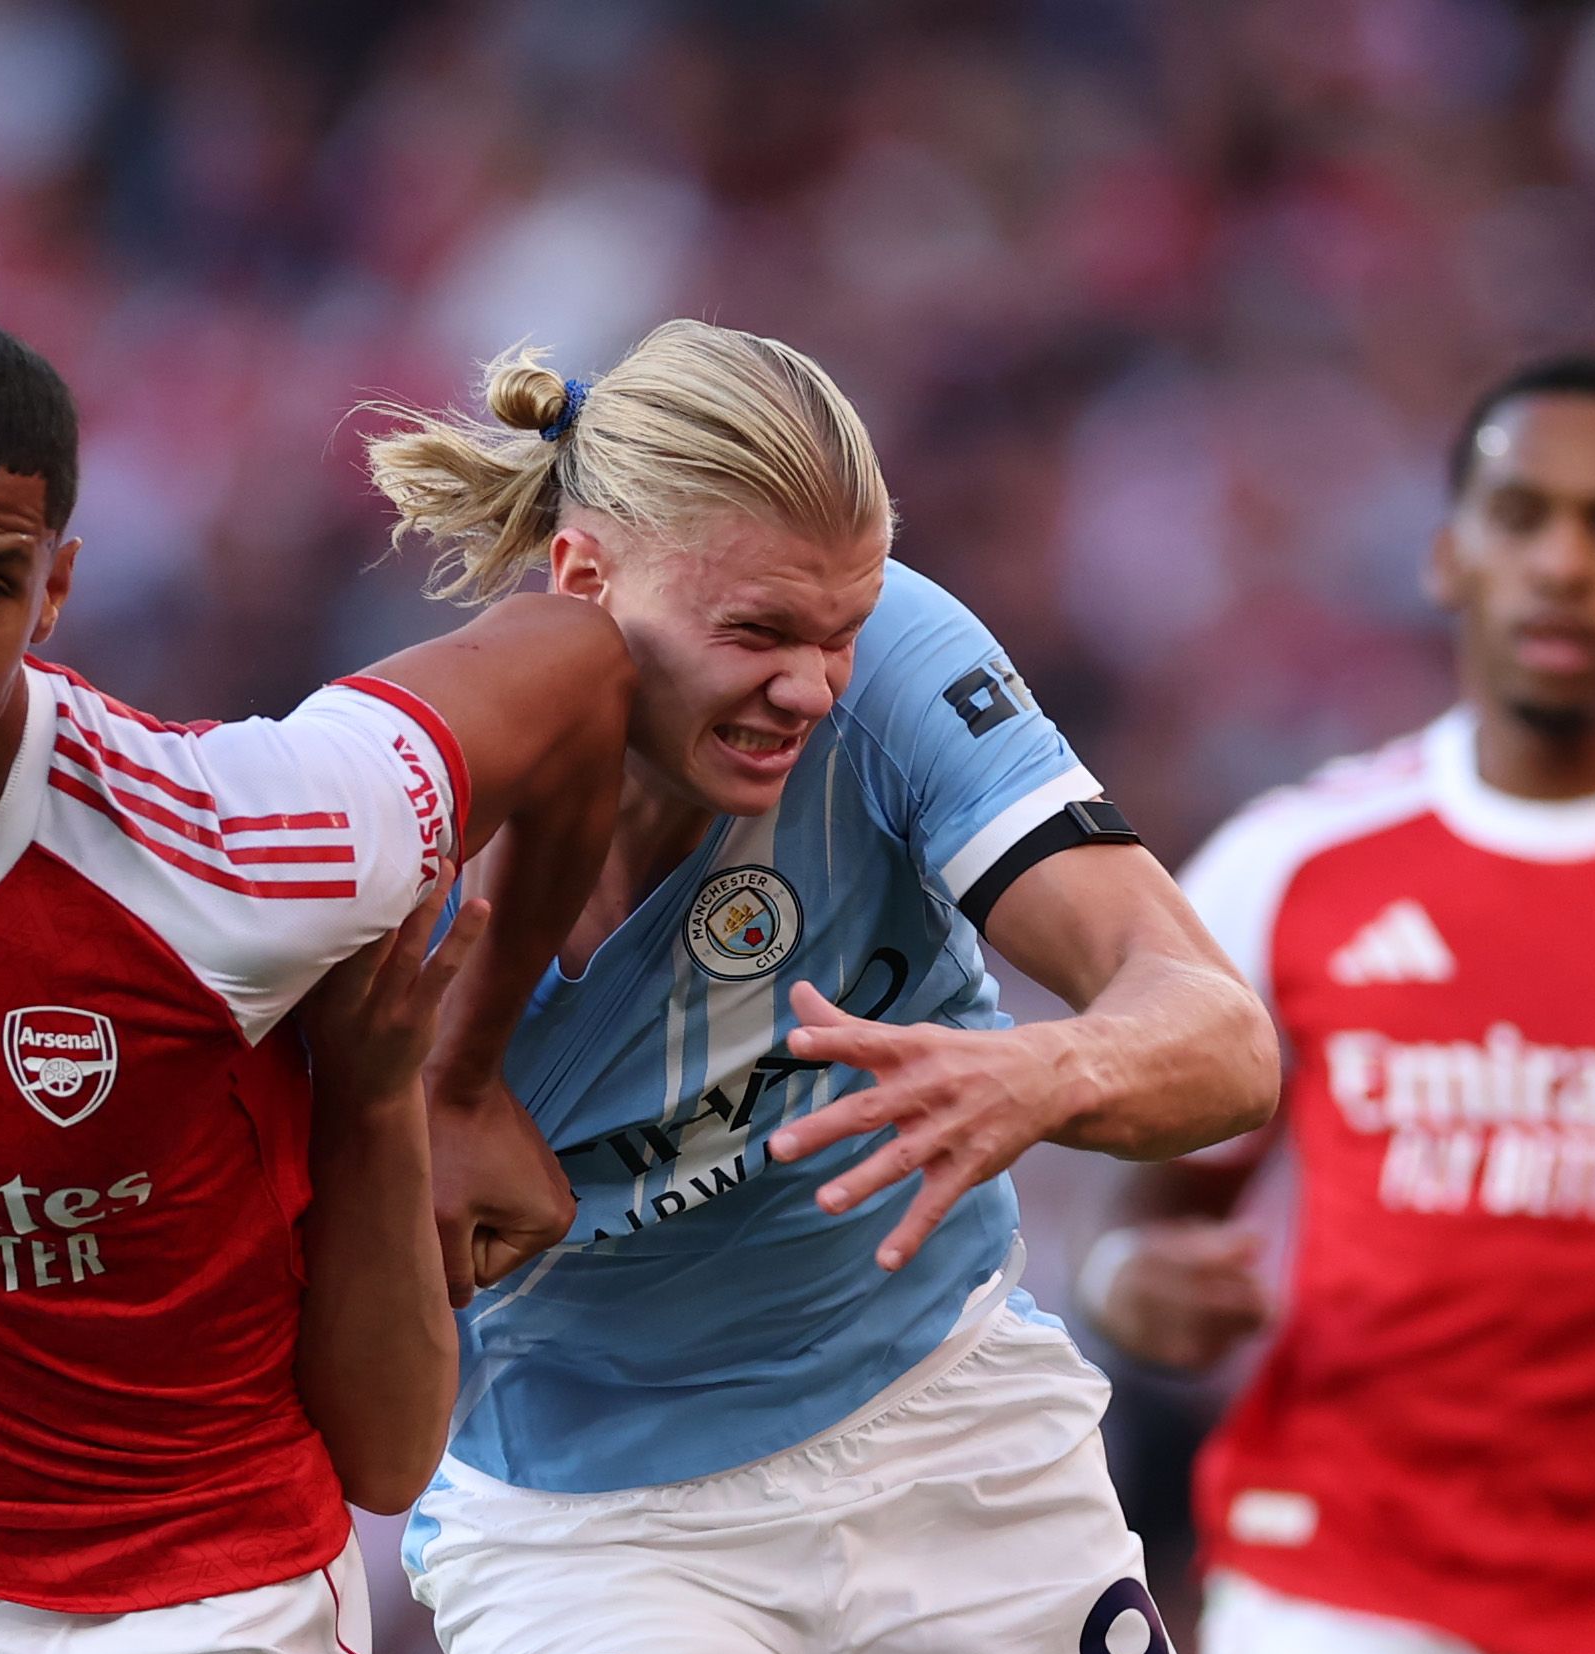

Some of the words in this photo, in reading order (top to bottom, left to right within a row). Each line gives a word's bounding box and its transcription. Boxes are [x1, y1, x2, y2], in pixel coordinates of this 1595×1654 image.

[693, 873, 768, 940] MANCHESTER
[756, 942, 785, 969] CITY
[19, 1026, 100, 1050] Arsenal
